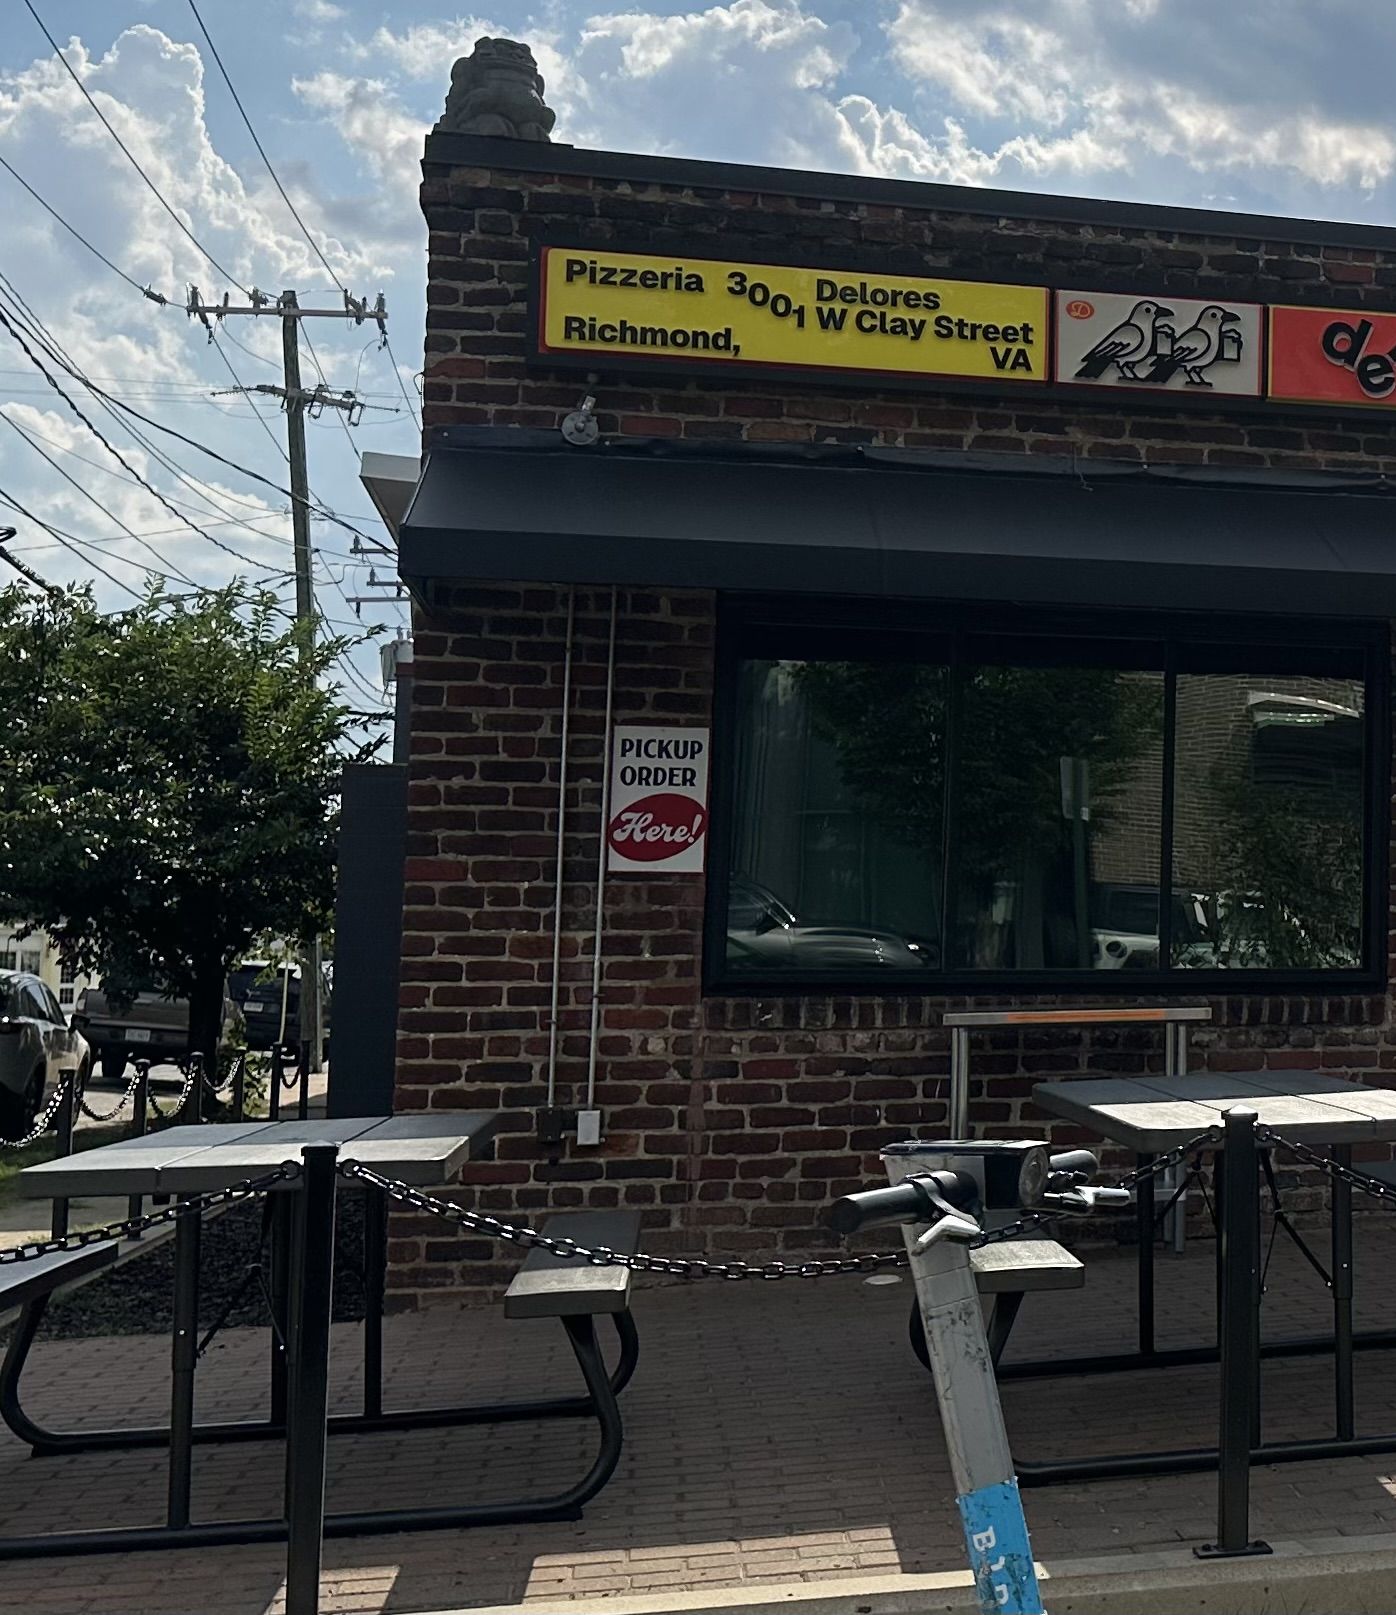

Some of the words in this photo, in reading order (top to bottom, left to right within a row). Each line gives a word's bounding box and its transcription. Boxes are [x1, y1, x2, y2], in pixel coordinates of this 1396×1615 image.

[565, 258, 704, 293] Pizzeria
[726, 271, 806, 328] 3001
[816, 278, 942, 311] Delores
[564, 315, 741, 357] Richmond,
[816, 305, 848, 331] W
[855, 312, 925, 341] Clay
[933, 315, 1034, 345] Street
[989, 345, 1034, 372] VA
[620, 738, 703, 760] PICKUP
[620, 765, 697, 787] ORDER
[612, 811, 703, 844] Here!
